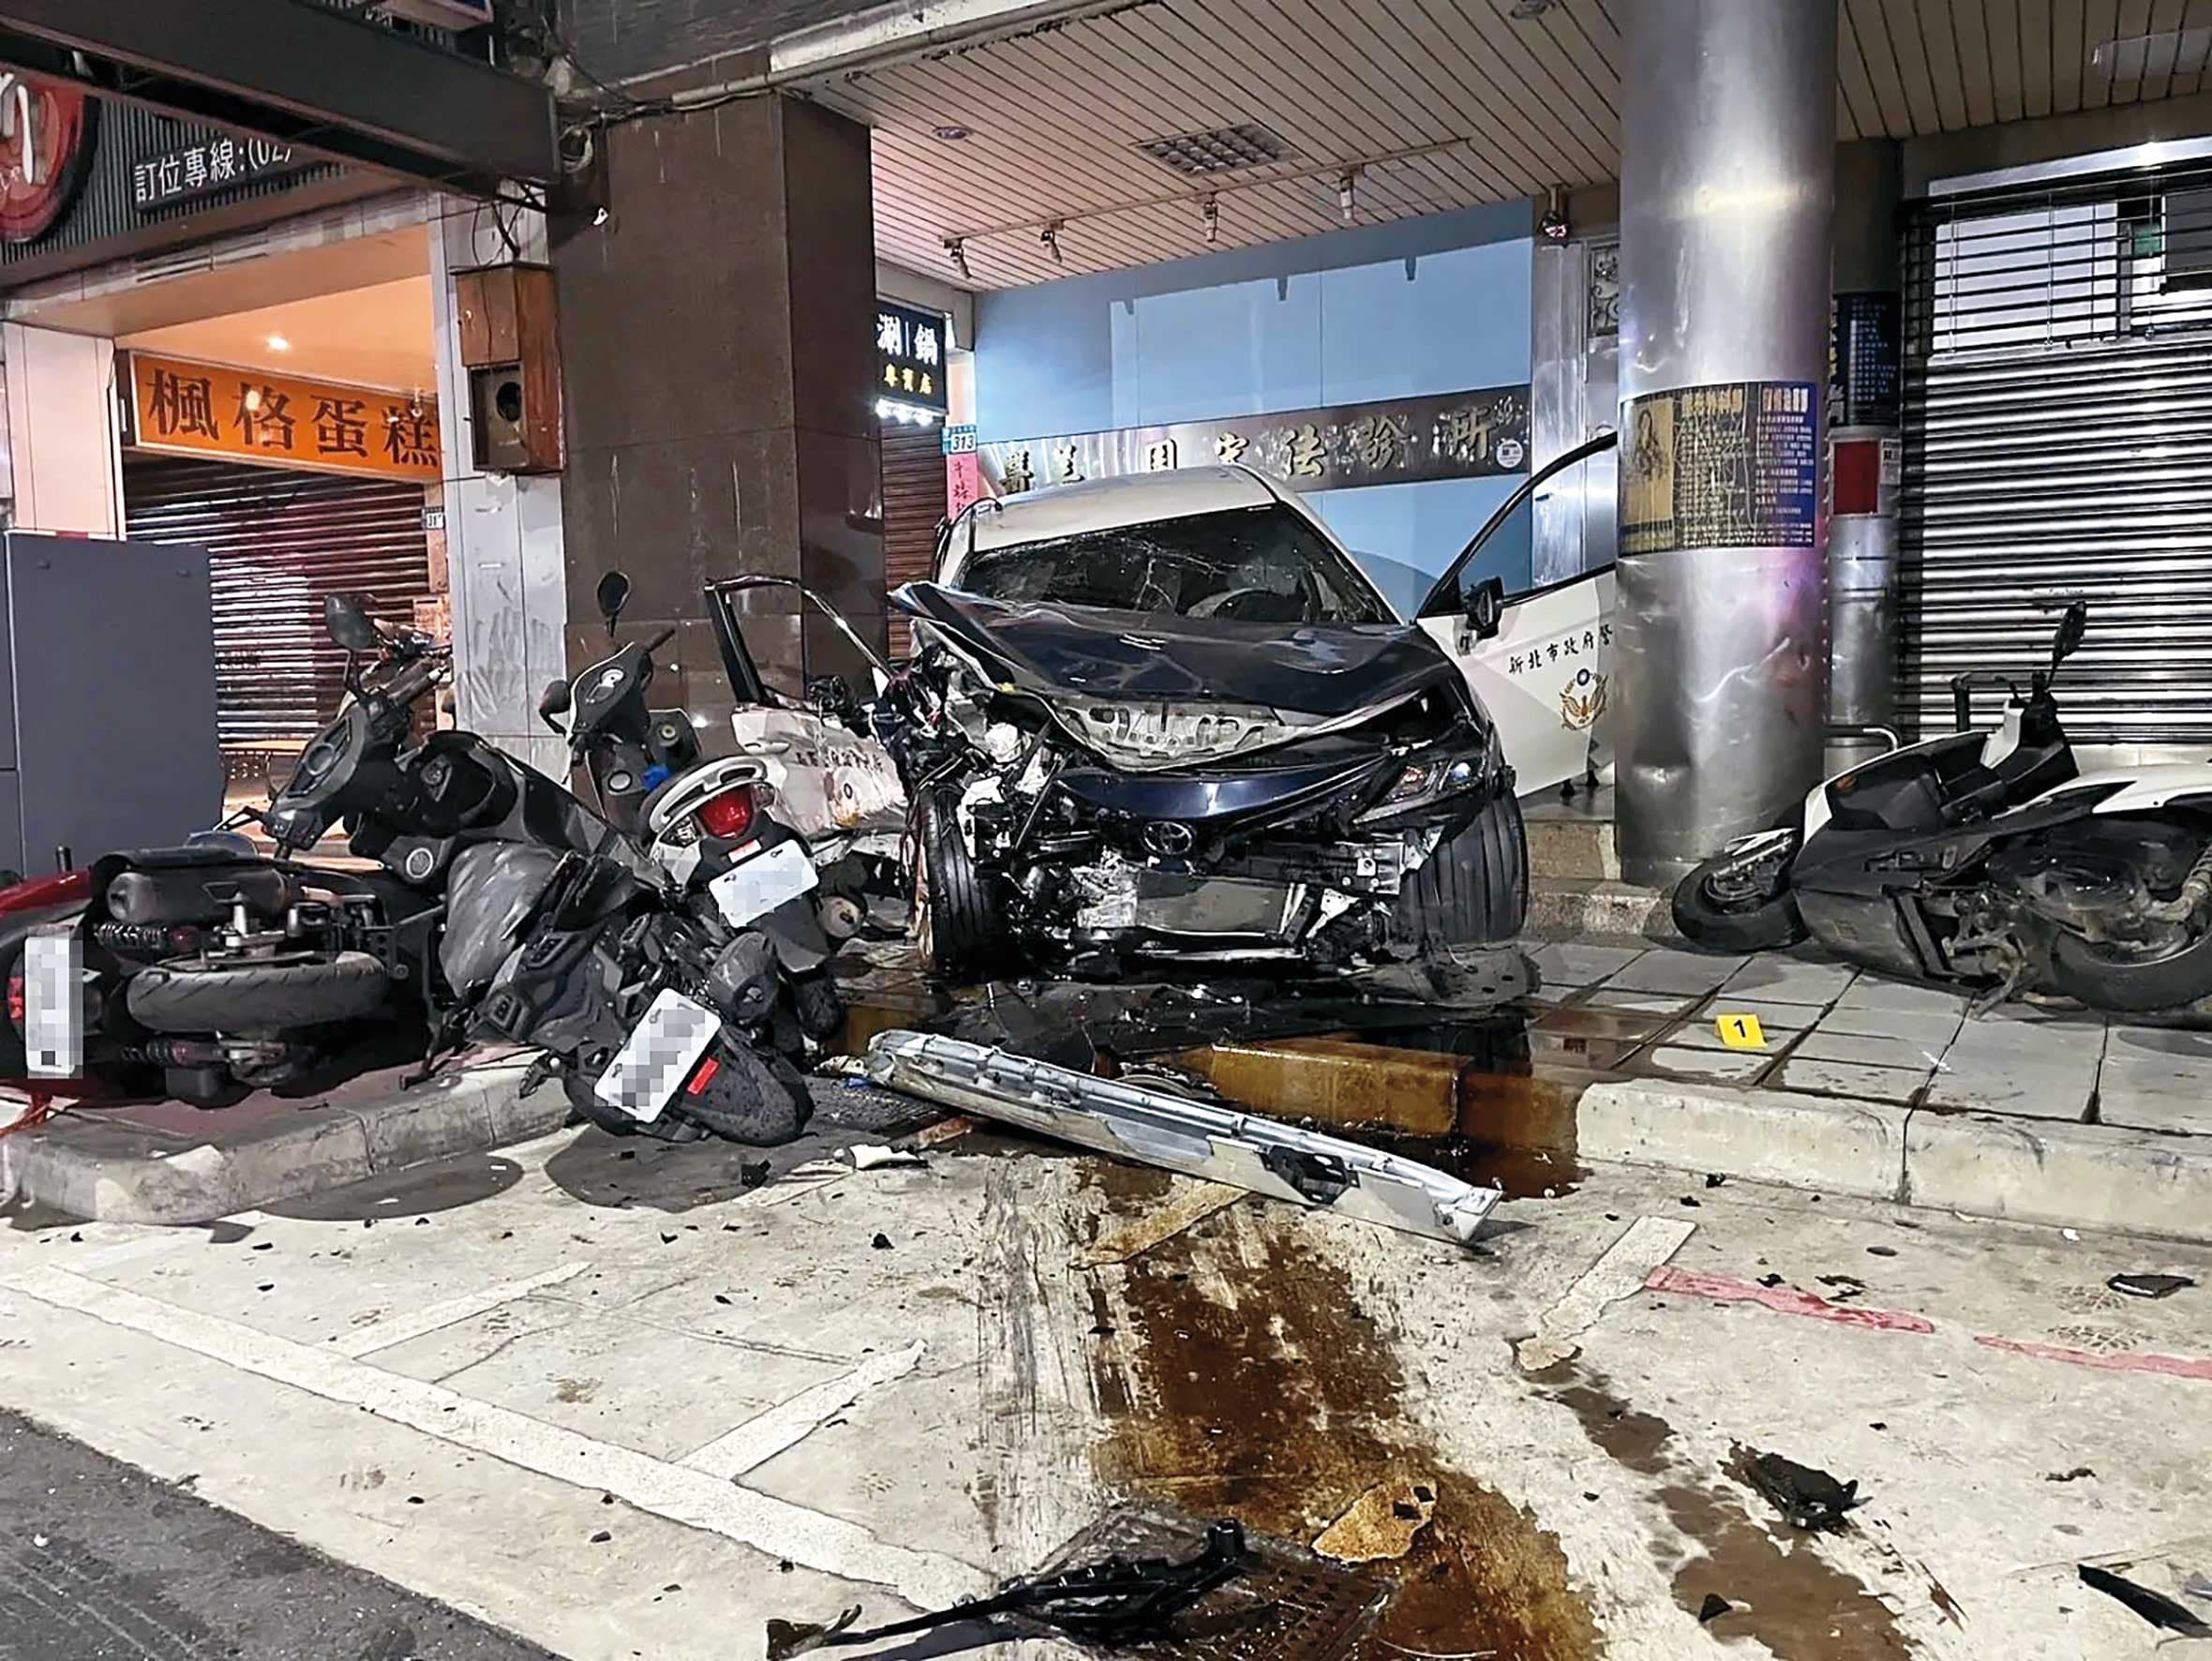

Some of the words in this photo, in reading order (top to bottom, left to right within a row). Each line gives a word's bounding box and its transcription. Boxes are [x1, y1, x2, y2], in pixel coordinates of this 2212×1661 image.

[146, 367, 439, 467] 楓格蛋糕
[952, 434, 975, 451] 313
[1733, 1019, 1746, 1039] 1
